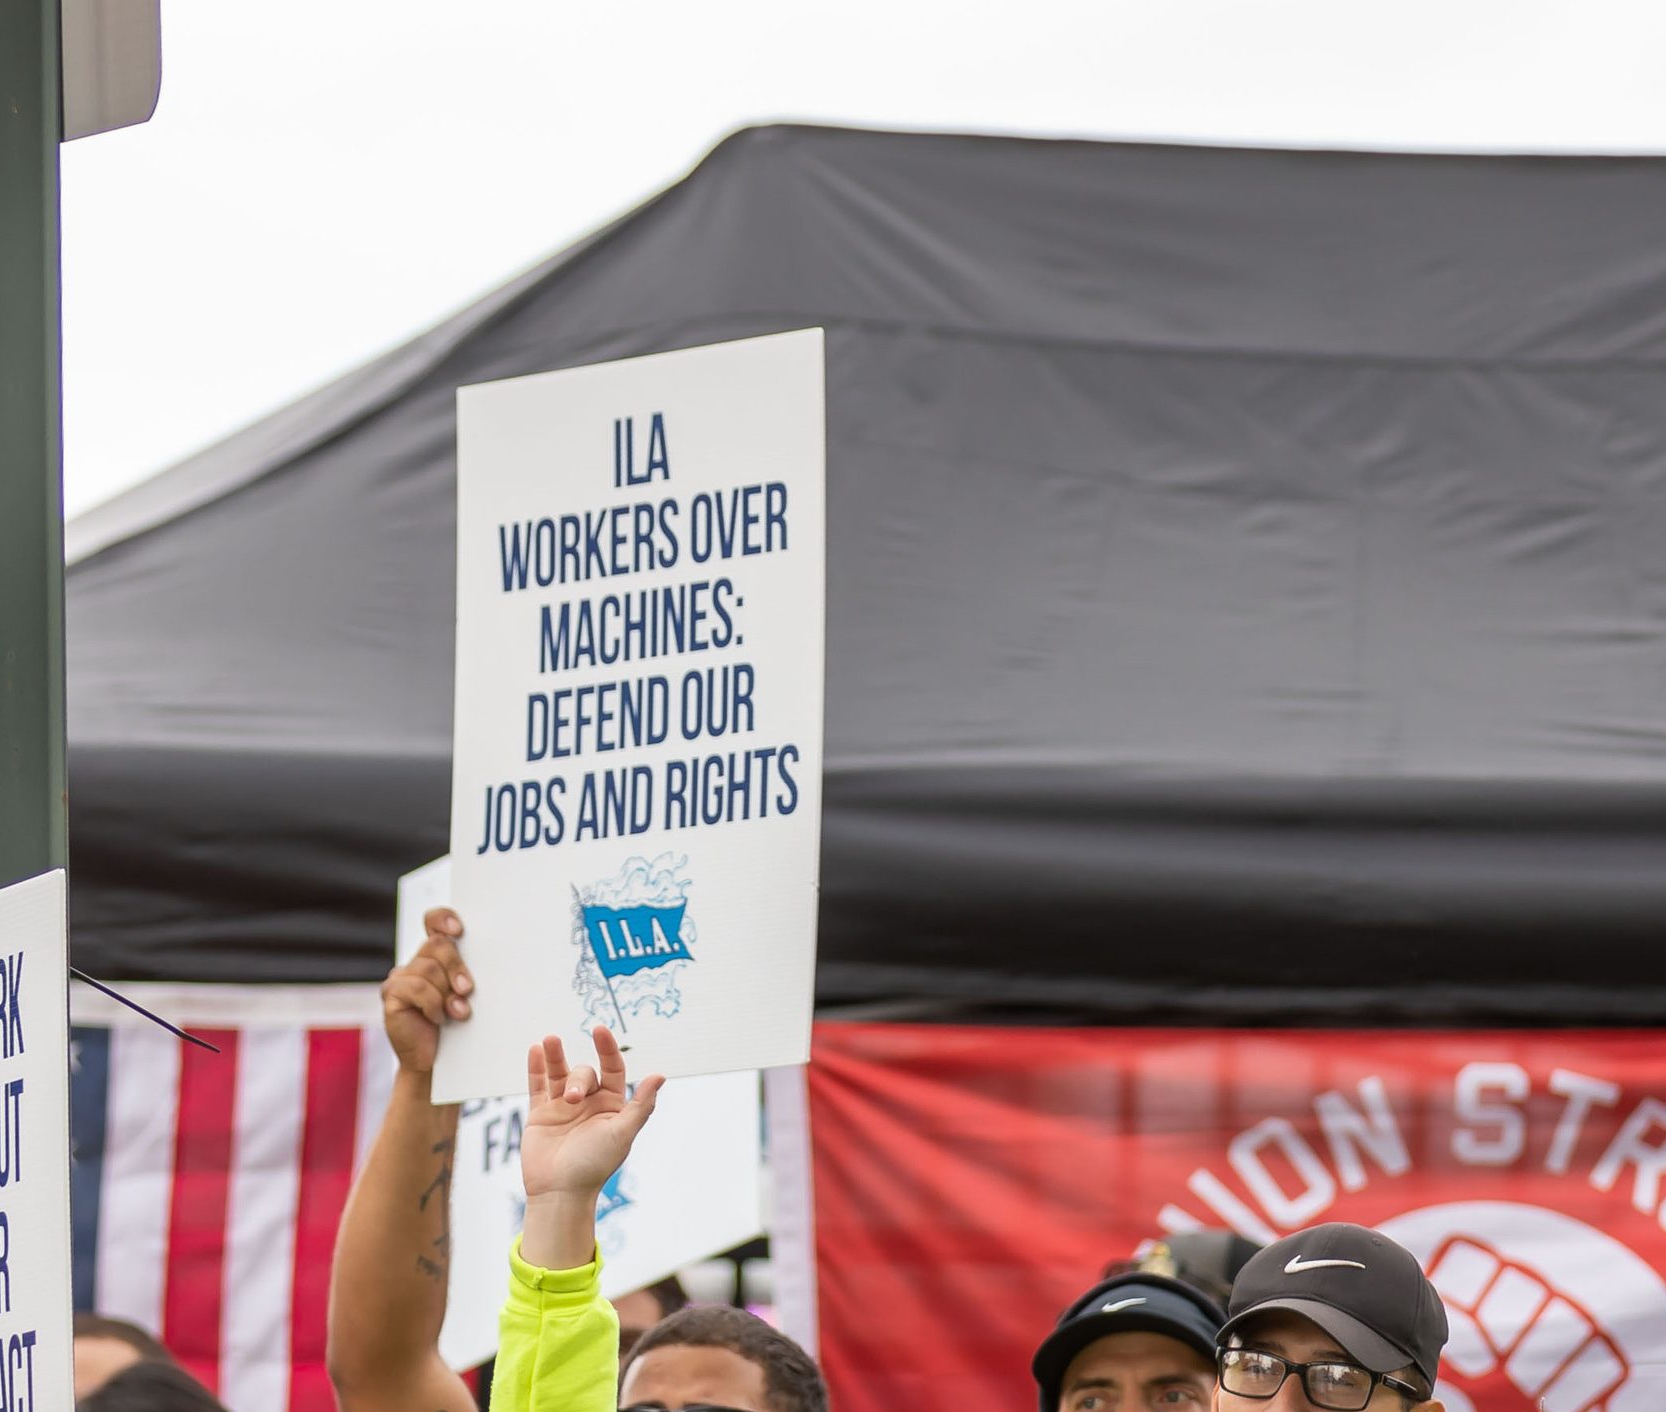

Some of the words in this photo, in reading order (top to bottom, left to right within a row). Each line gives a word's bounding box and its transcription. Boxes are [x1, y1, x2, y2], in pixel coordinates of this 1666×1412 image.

[614, 411, 670, 489] ILA
[498, 498, 679, 593] WORKERS
[690, 481, 788, 565] OVER
[538, 577, 744, 674] MACHINES:
[527, 676, 668, 763] DEFEND
[680, 663, 755, 739] OUR
[476, 775, 565, 857] JOBS
[575, 765, 655, 842] AND
[666, 744, 800, 826] RIGHTS
[598, 911, 681, 962] I.L.A.
[1153, 1076, 1413, 1246] ION
